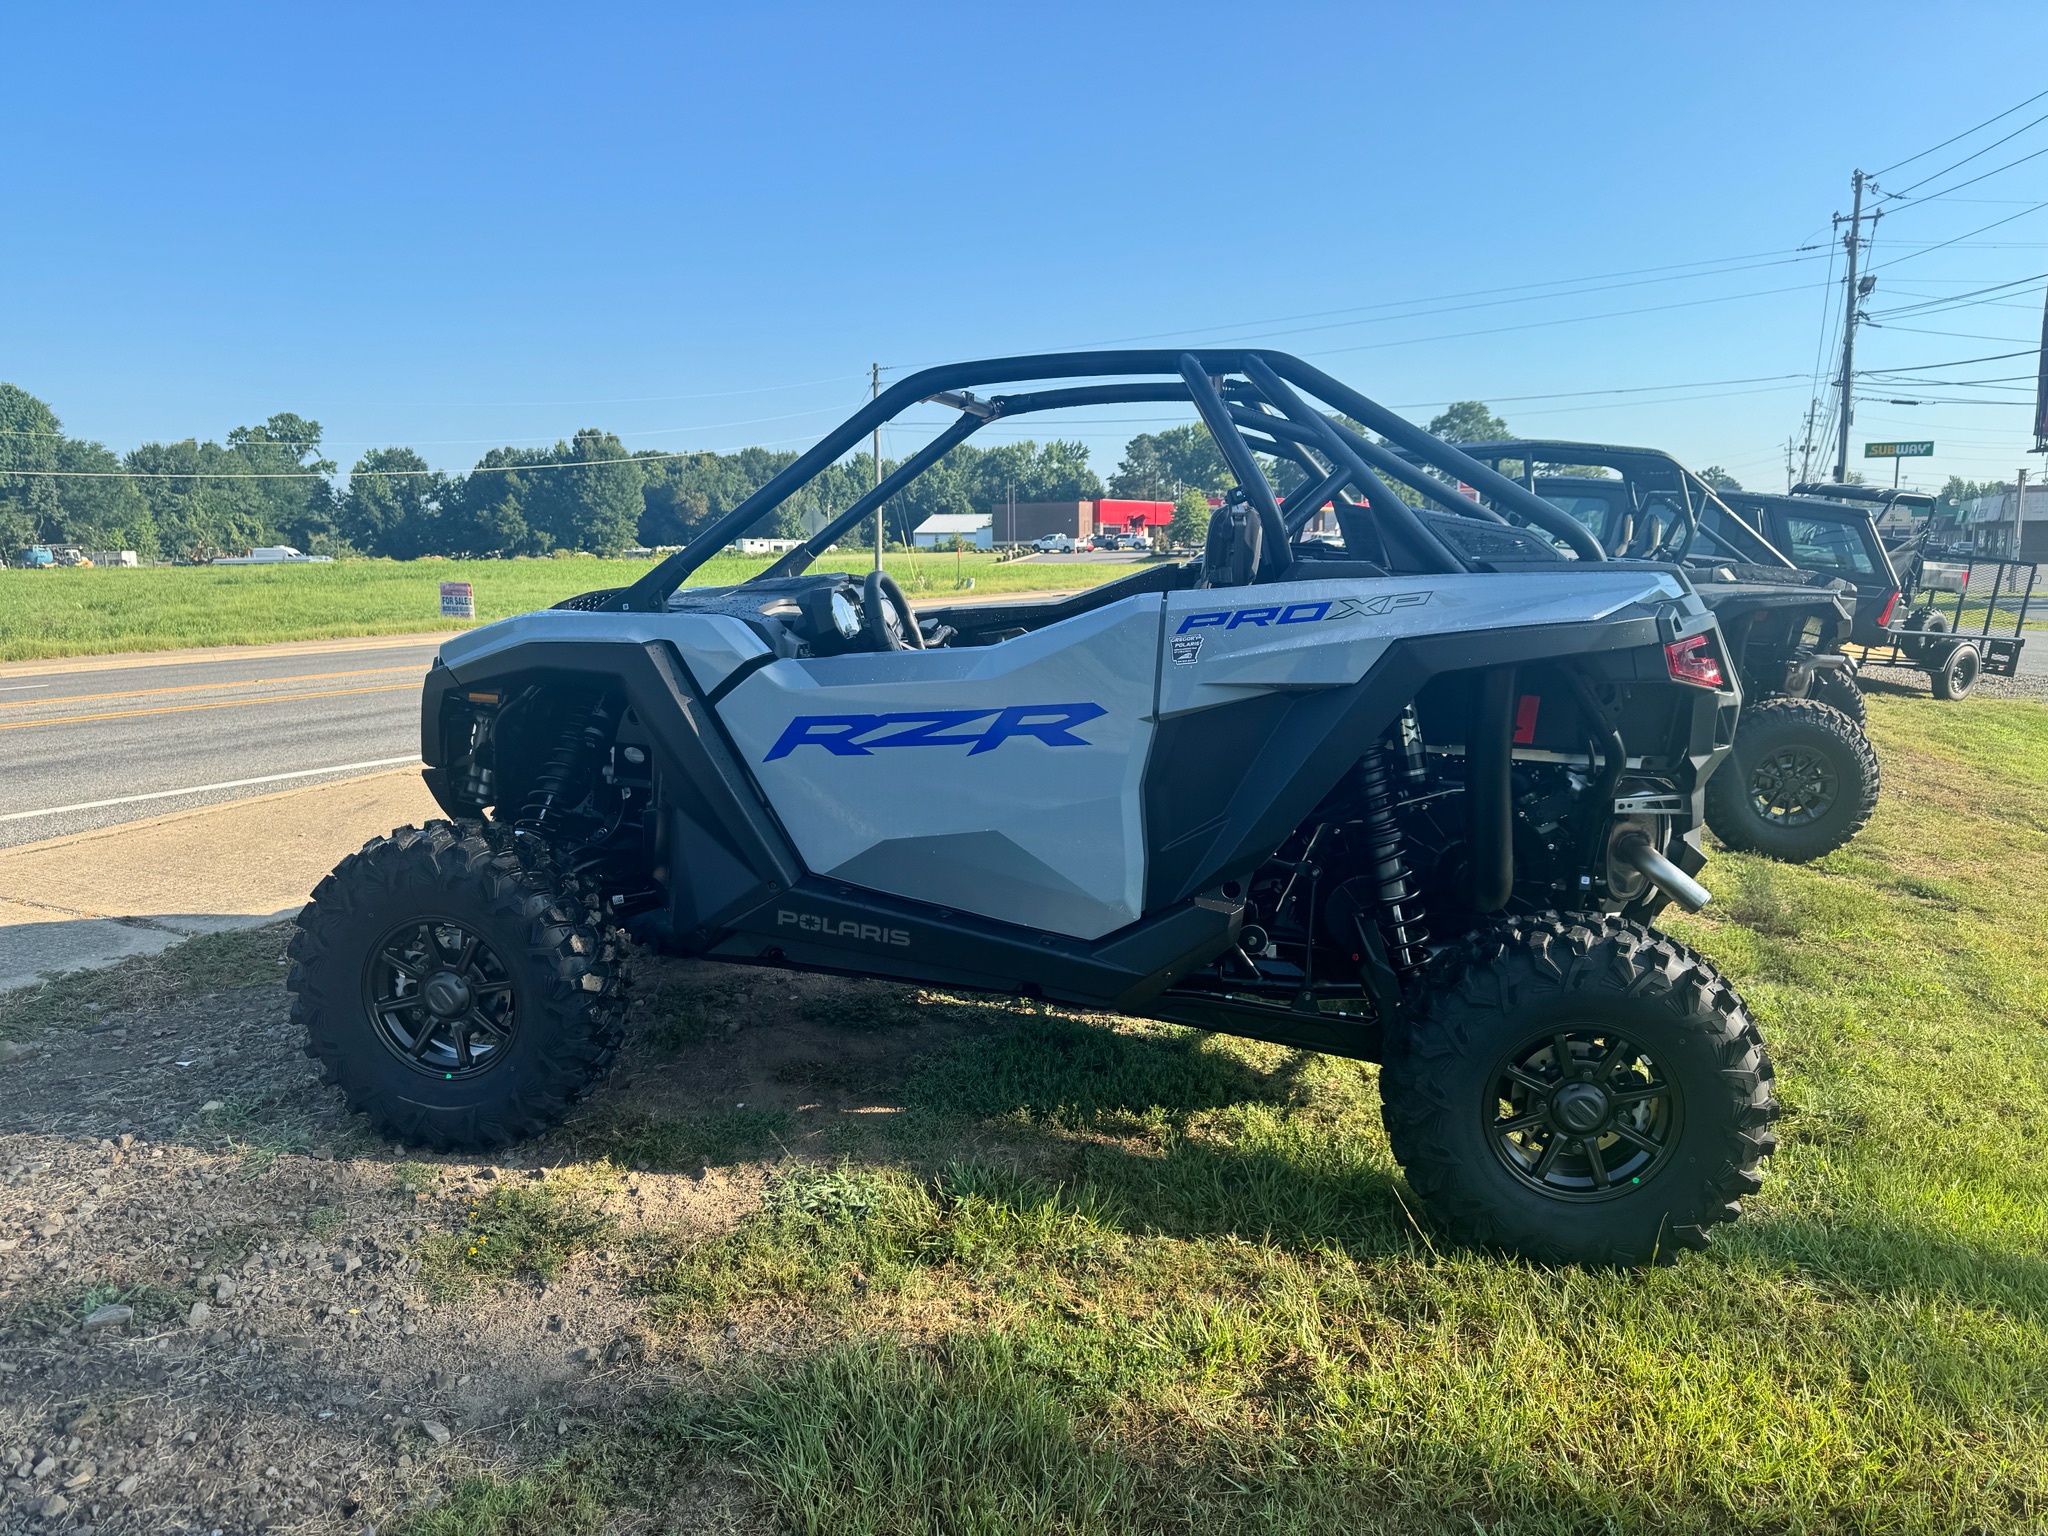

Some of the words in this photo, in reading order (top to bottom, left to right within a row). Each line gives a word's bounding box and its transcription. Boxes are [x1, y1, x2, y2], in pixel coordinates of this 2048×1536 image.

[1869, 443, 1931, 456] SUBWAY
[441, 596, 454, 605] FOR
[455, 596, 469, 606] SALE
[1175, 601, 1333, 635] PRO
[1324, 590, 1434, 621] XP
[762, 702, 1109, 763] RZR
[777, 909, 911, 947] POLARIS
